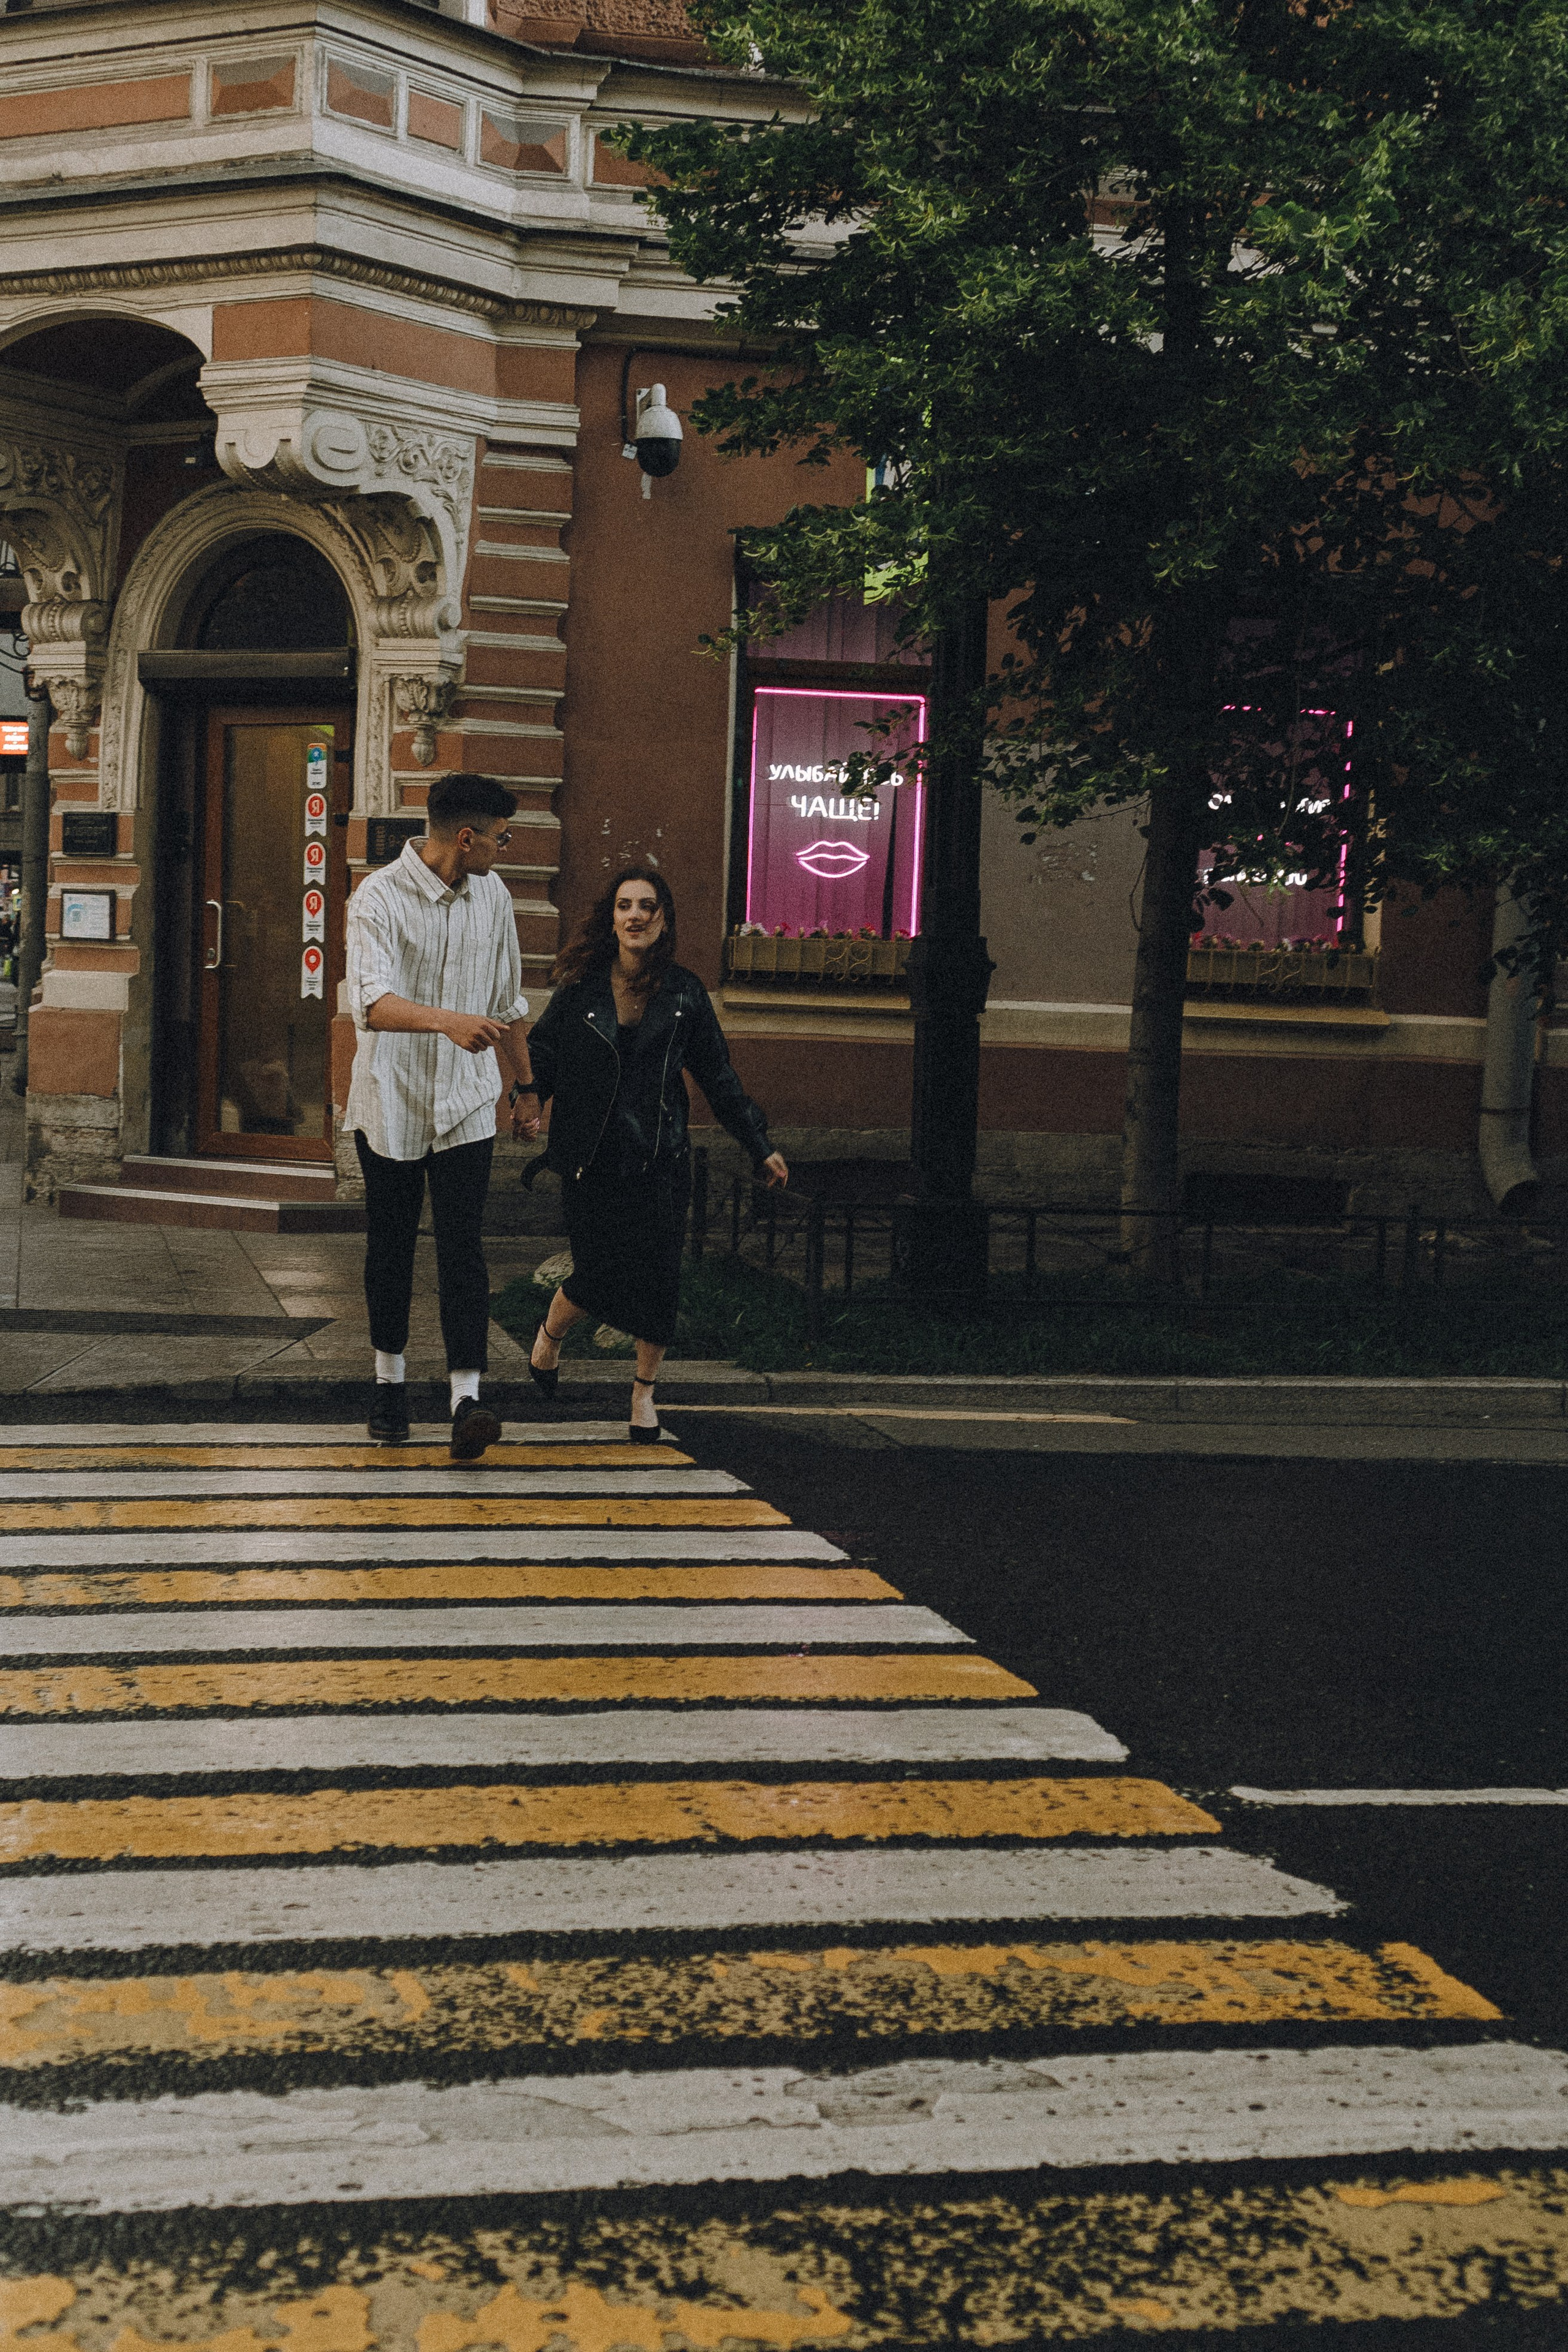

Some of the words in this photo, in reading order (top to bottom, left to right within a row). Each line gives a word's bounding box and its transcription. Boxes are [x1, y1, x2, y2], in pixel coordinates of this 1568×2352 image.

[312, 799, 320, 813] Я
[791, 795, 880, 821] ЧАЩЕ!
[311, 848, 318, 862] Я
[309, 896, 317, 910] Я
